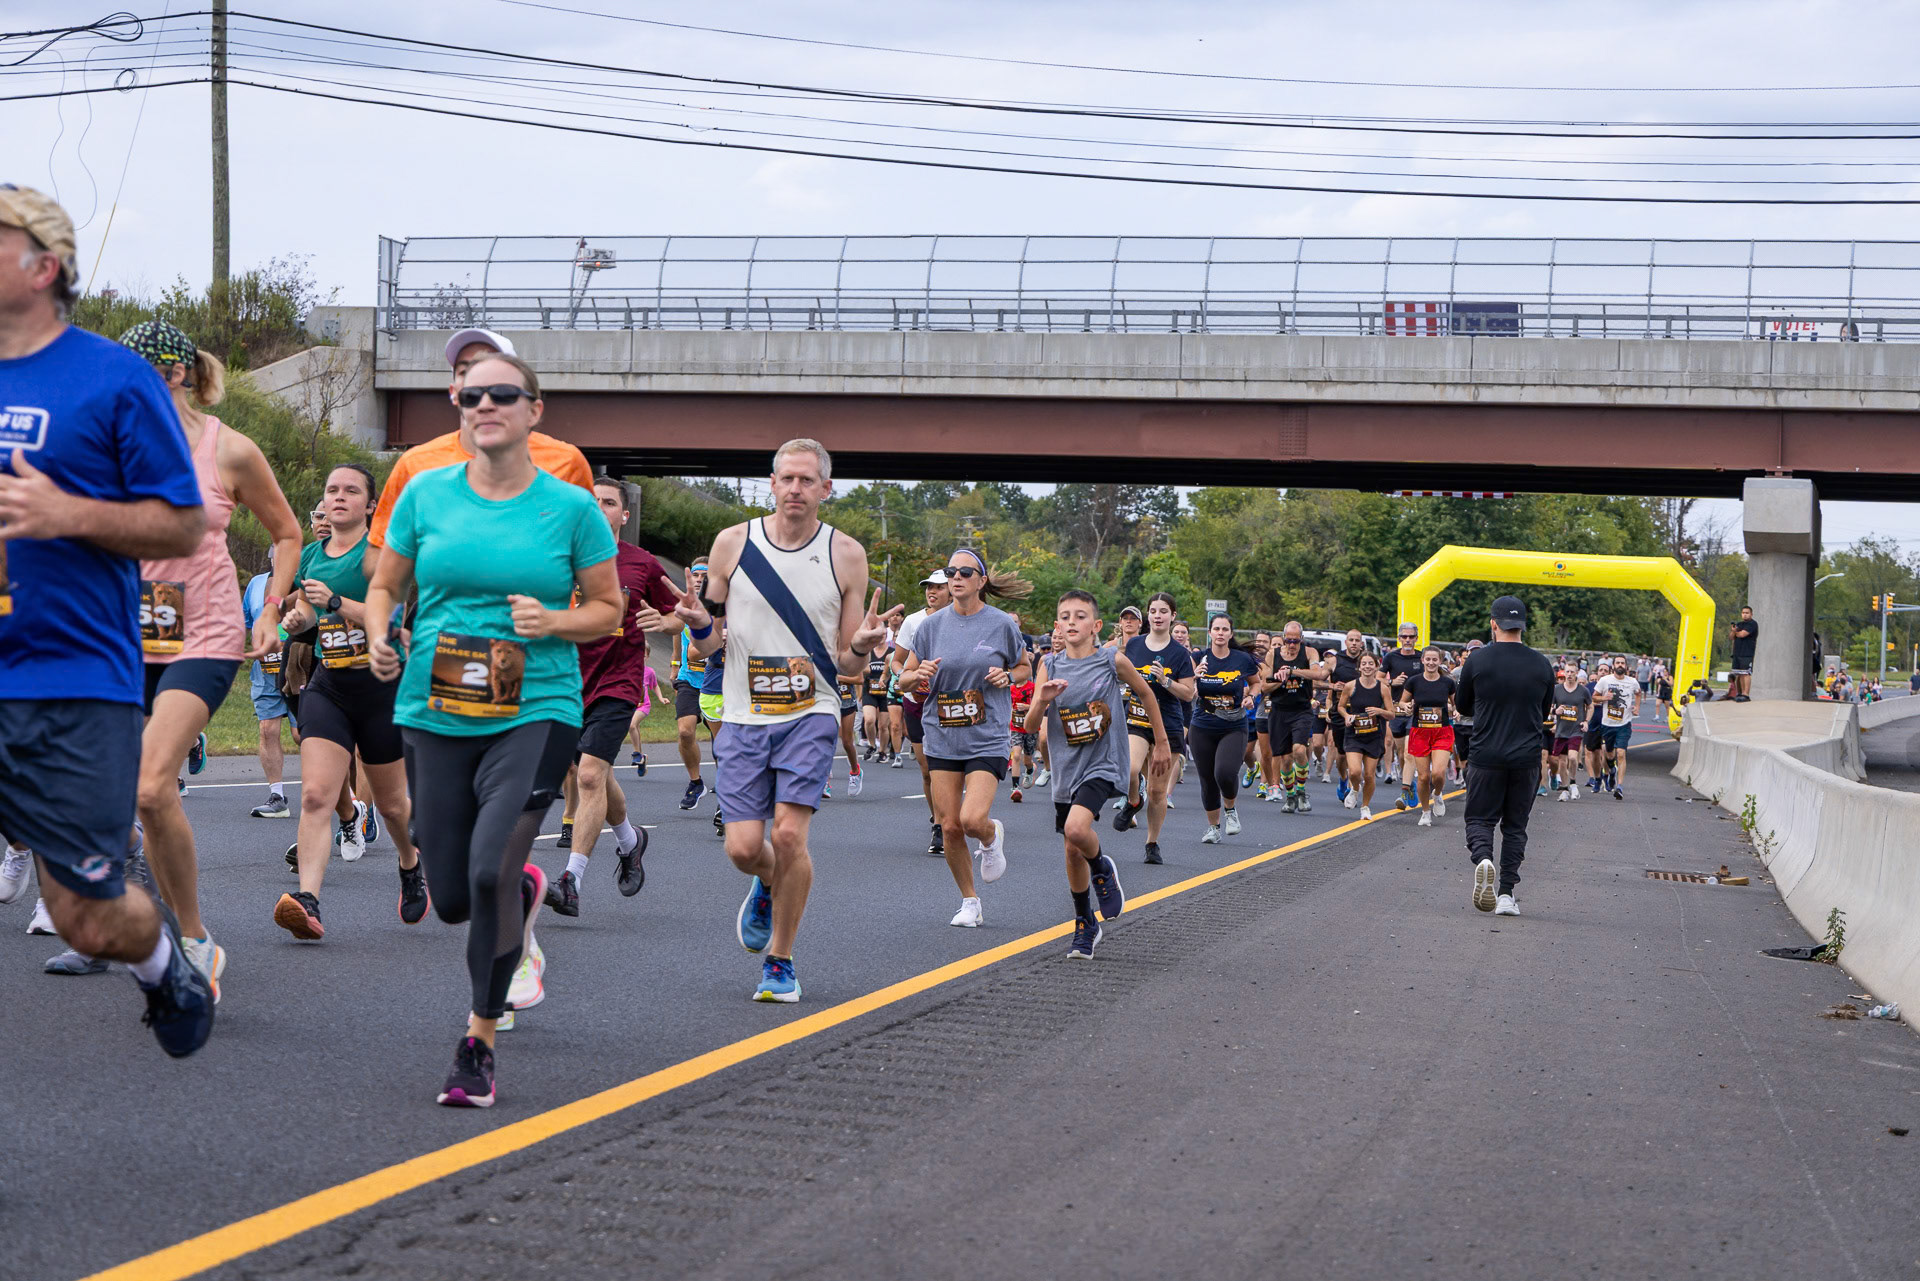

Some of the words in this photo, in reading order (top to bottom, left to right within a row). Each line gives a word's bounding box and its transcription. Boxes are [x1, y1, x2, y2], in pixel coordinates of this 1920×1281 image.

[11, 413, 35, 431] US
[321, 629, 366, 648] 322
[439, 636, 457, 645] THE
[436, 646, 470, 657] CHASE
[462, 662, 488, 686] 2
[753, 674, 810, 692] 229
[942, 703, 979, 718] 128
[1131, 705, 1149, 717] 19
[1421, 713, 1439, 721] 170
[1067, 714, 1104, 735] 127
[1358, 719, 1374, 727] 171
